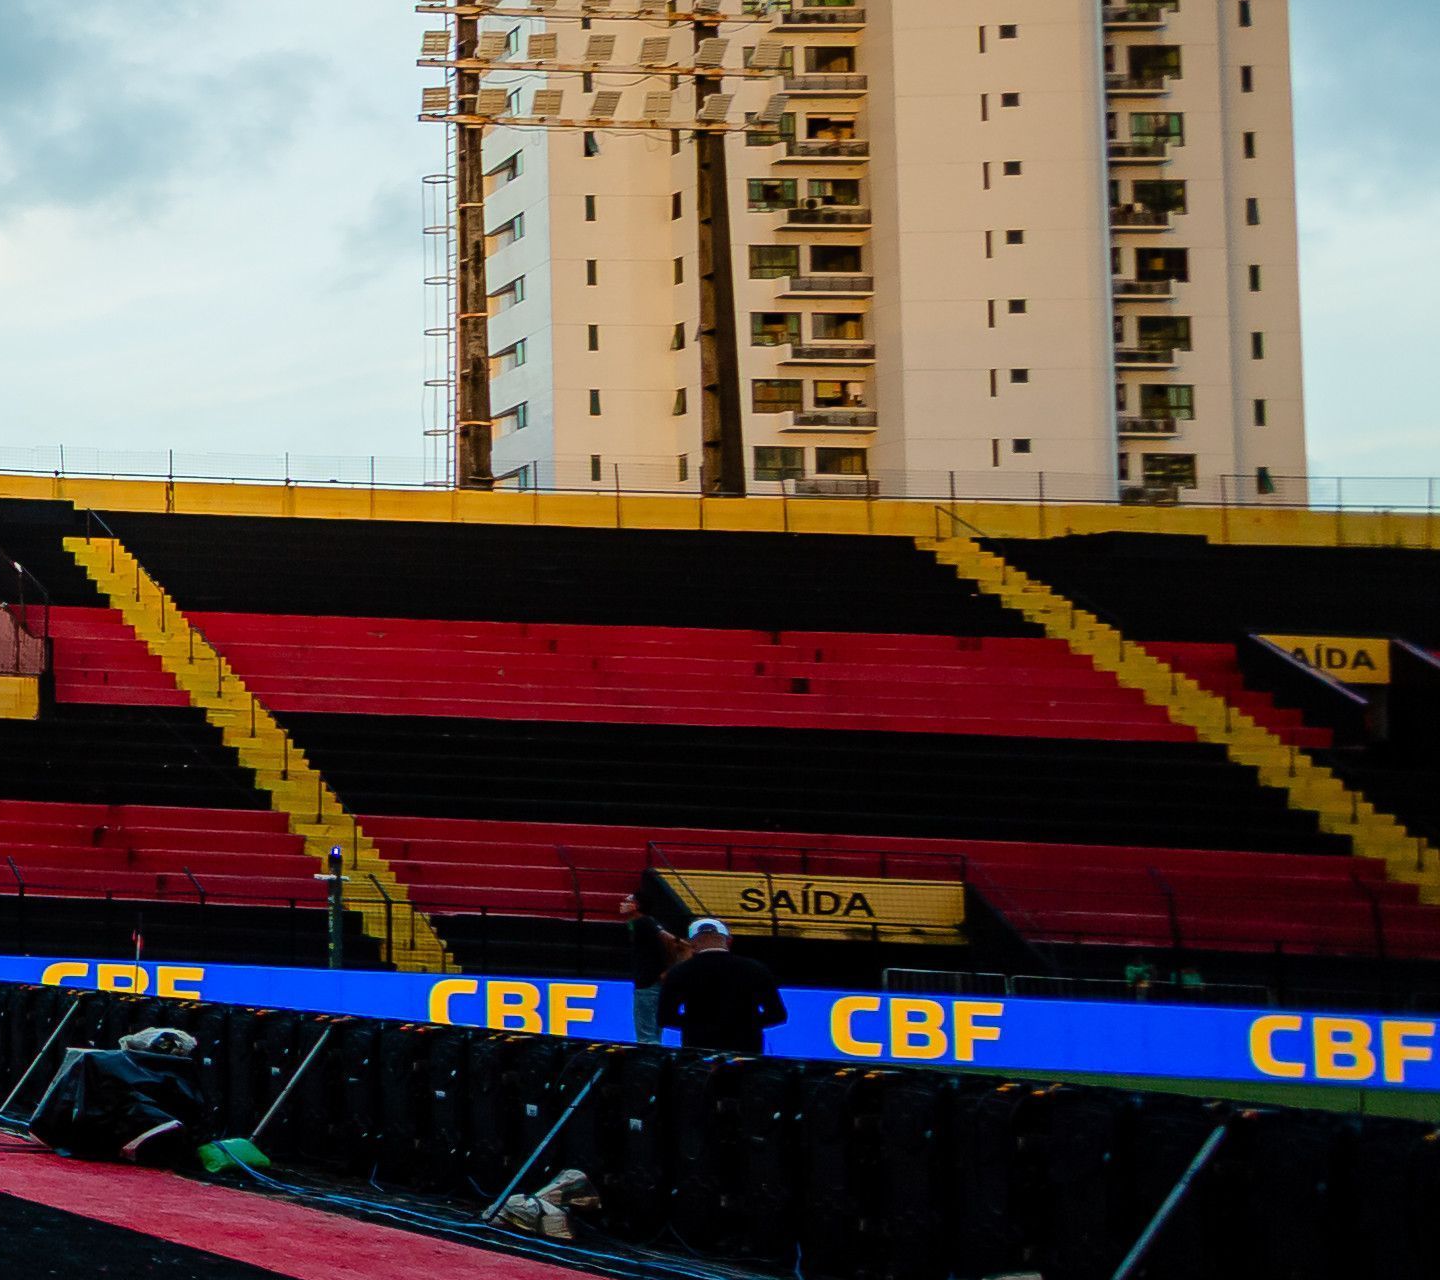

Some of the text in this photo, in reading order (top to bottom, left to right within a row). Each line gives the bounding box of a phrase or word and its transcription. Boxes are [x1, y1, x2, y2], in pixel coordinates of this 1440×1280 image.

[738, 882, 875, 917] SAÍDA
[428, 978, 599, 1036] CBF
[830, 995, 1005, 1062] CBF
[1249, 1014, 1436, 1083] CBF
